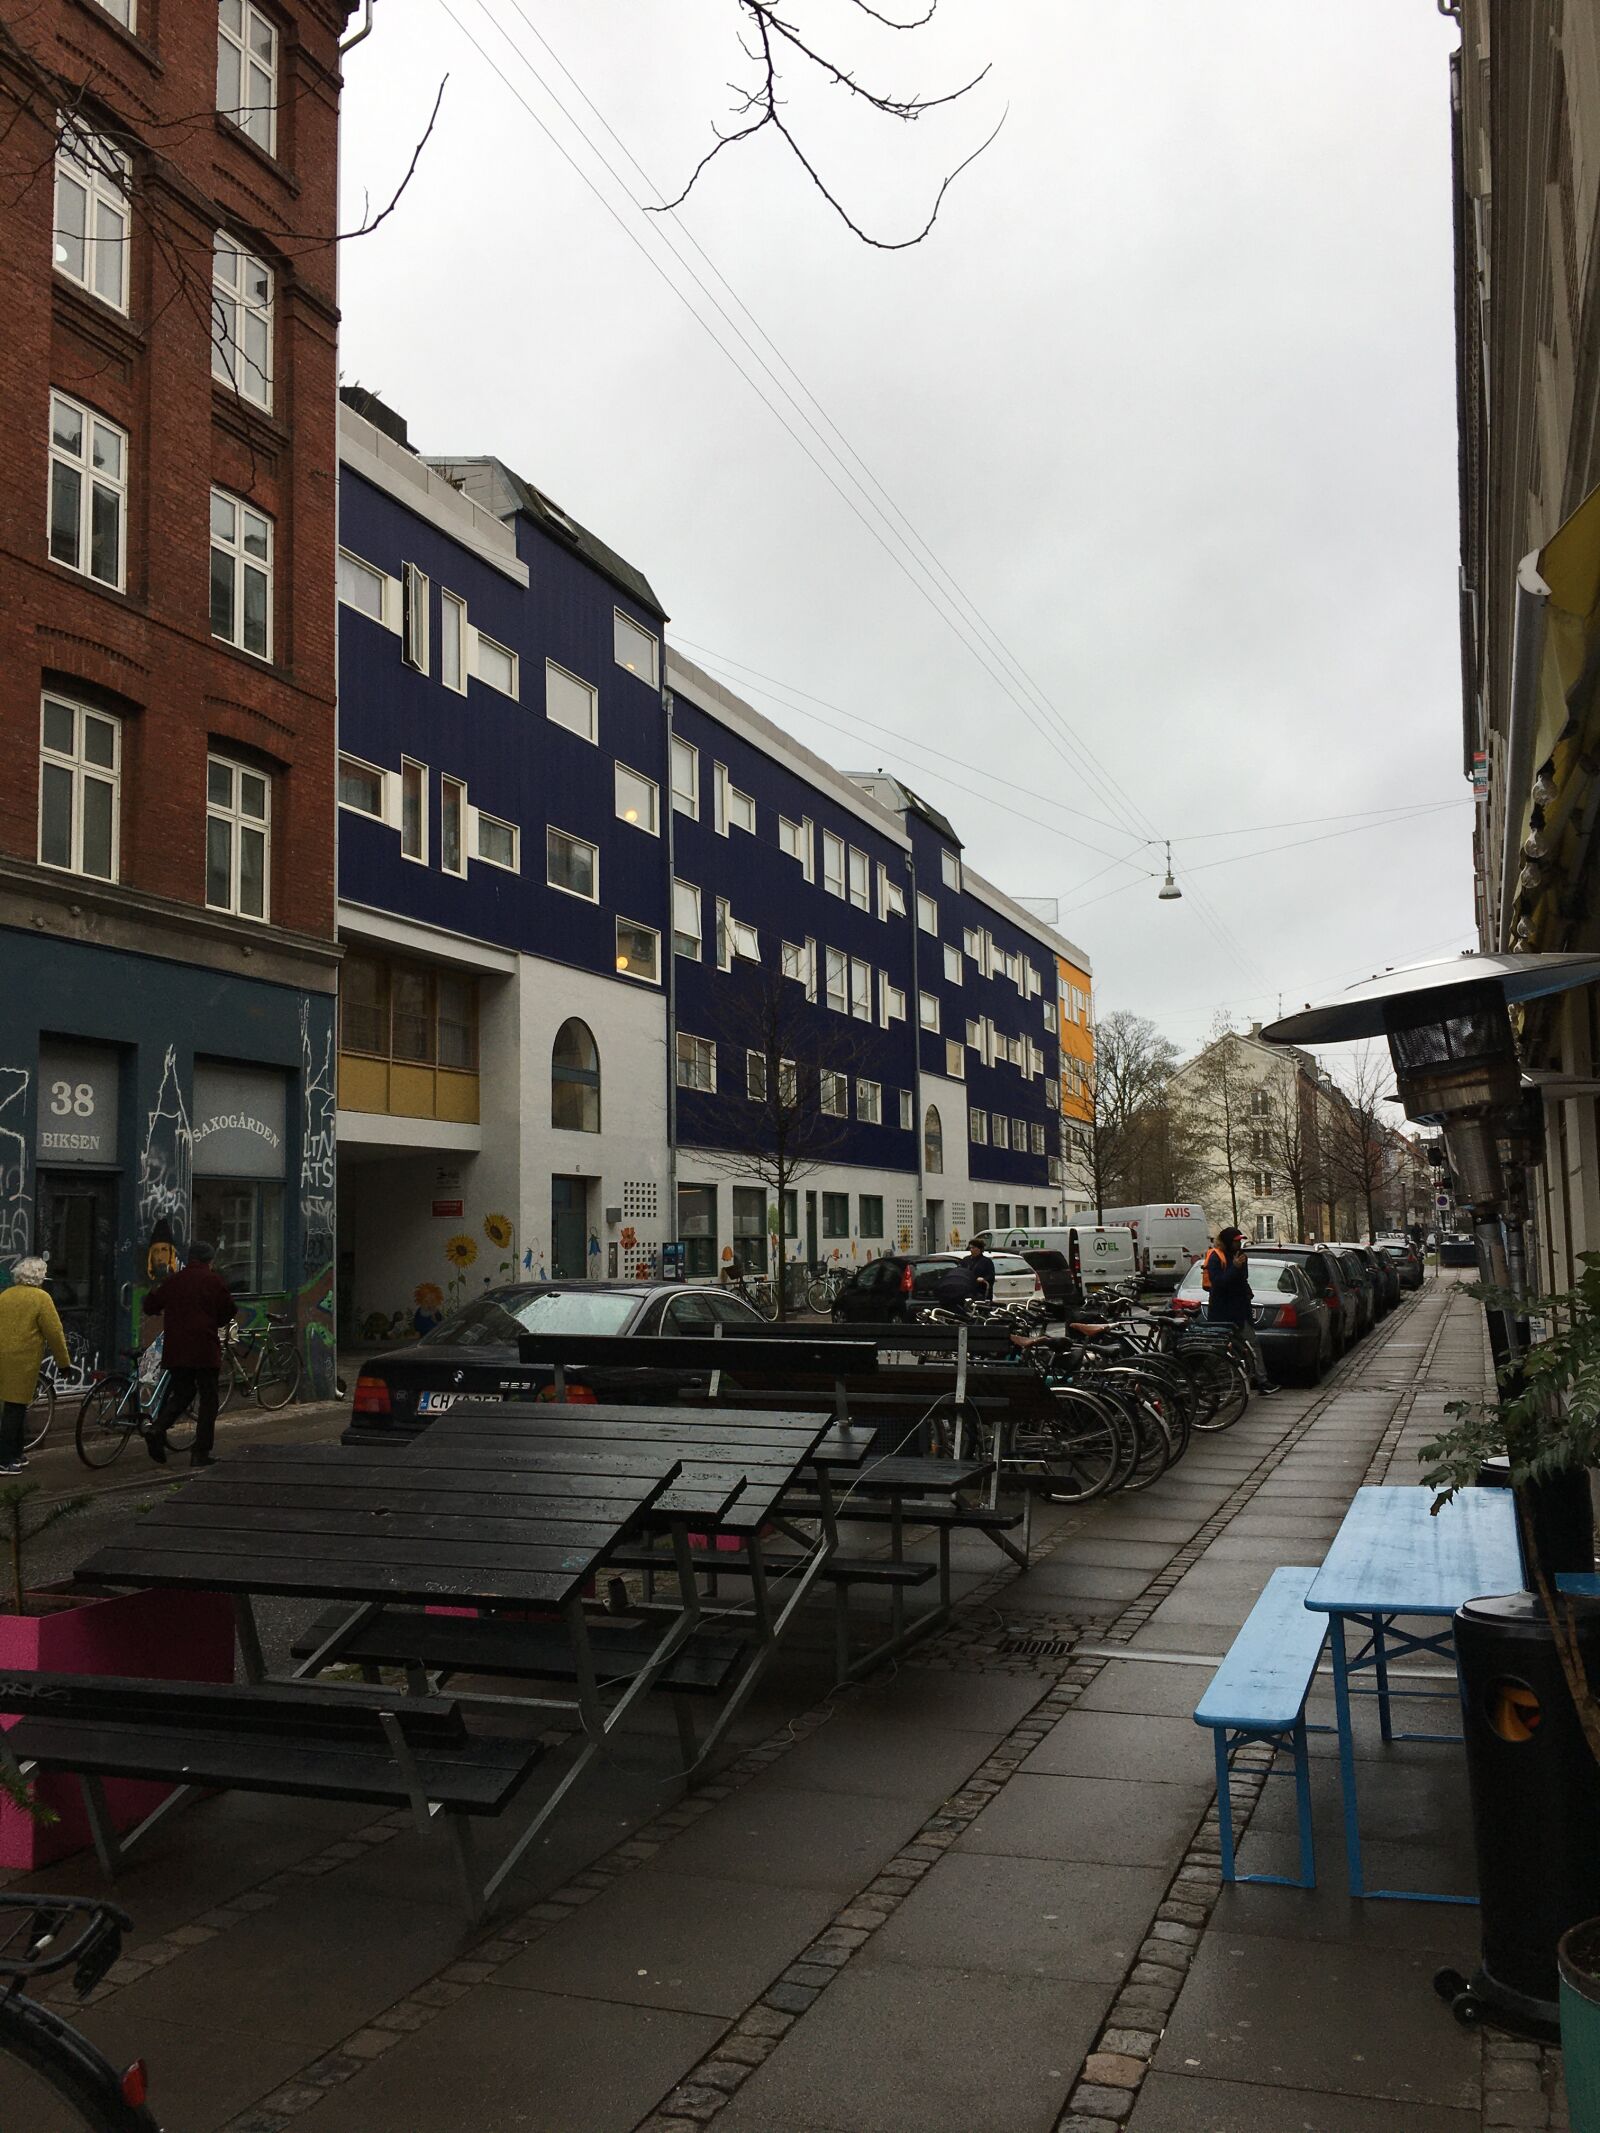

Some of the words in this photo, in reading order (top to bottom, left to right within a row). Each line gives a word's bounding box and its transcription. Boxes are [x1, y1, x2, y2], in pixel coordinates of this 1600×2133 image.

[51, 1081, 95, 1117] 38
[192, 1112, 281, 1149] SAXOGÅRDEN
[41, 1132, 100, 1151] BIKSEN
[1164, 1207, 1191, 1218] AVIS
[1096, 1241, 1119, 1251] ATEL
[431, 1394, 450, 1409] CH
